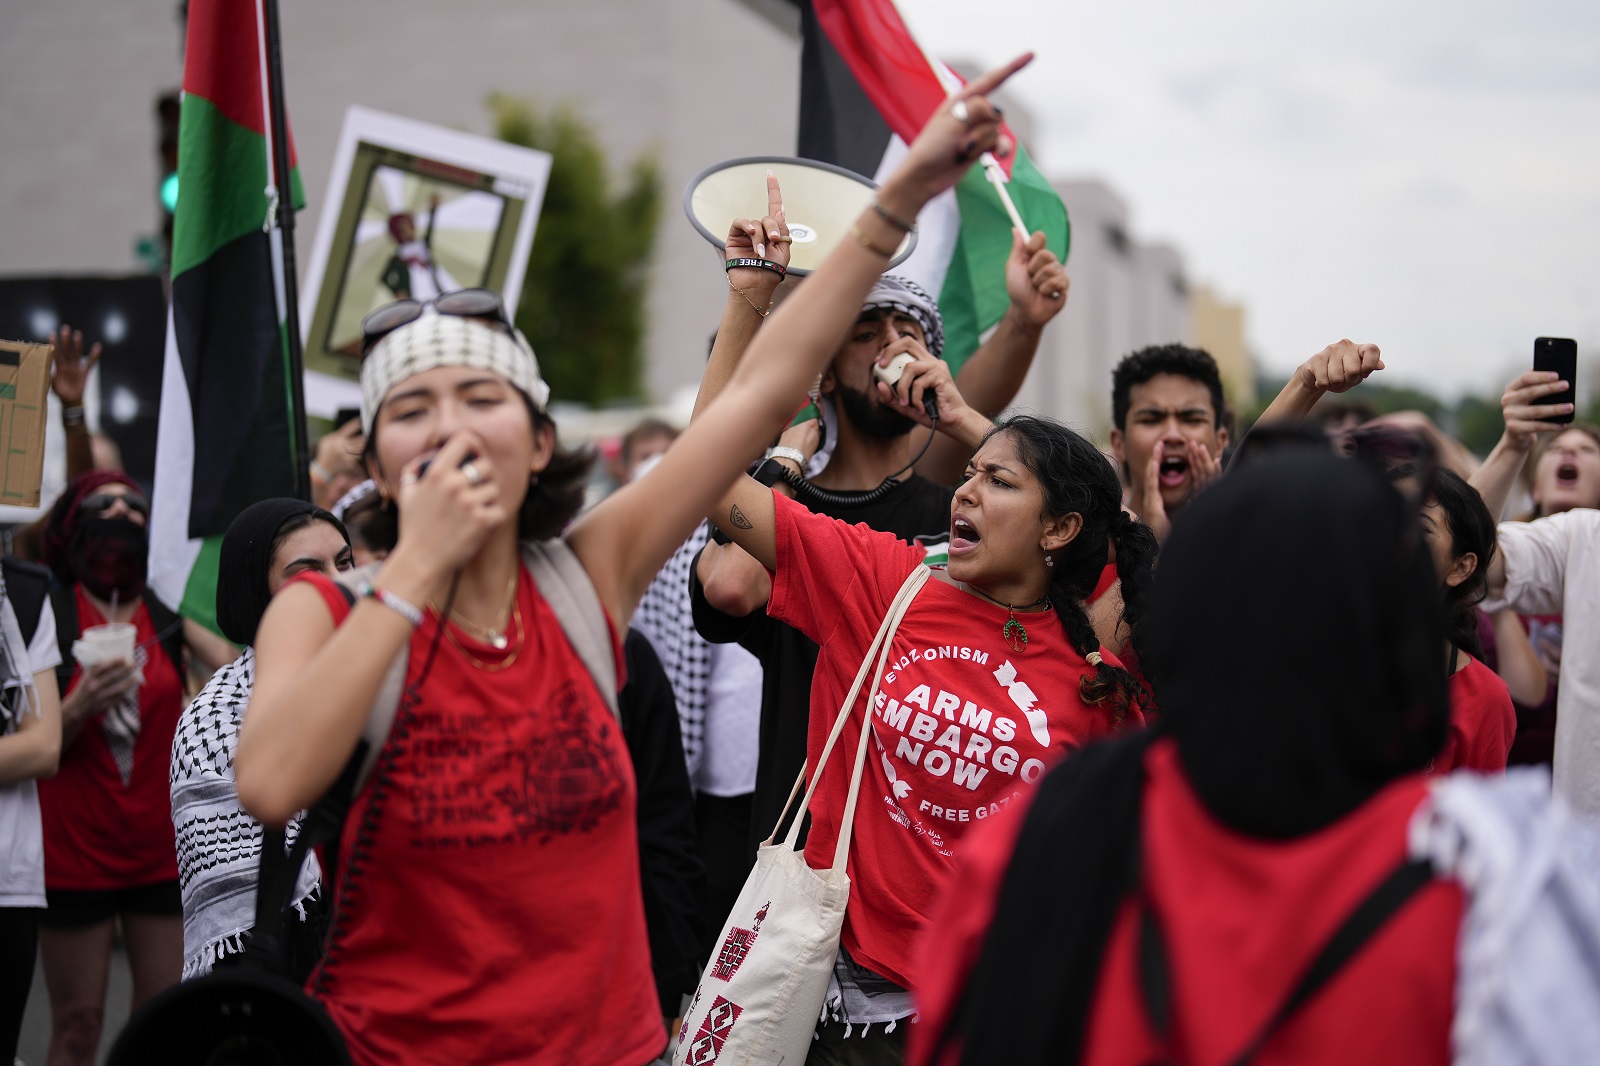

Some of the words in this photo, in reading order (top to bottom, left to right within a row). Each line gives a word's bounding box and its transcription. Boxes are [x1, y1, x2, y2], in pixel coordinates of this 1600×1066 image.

[739, 258, 763, 267] FREE
[909, 645, 990, 666] ZONISM
[904, 684, 1017, 742] ARMS
[875, 690, 1046, 785] EMBARGO
[895, 736, 989, 791] NOW
[919, 799, 970, 822] FREE
